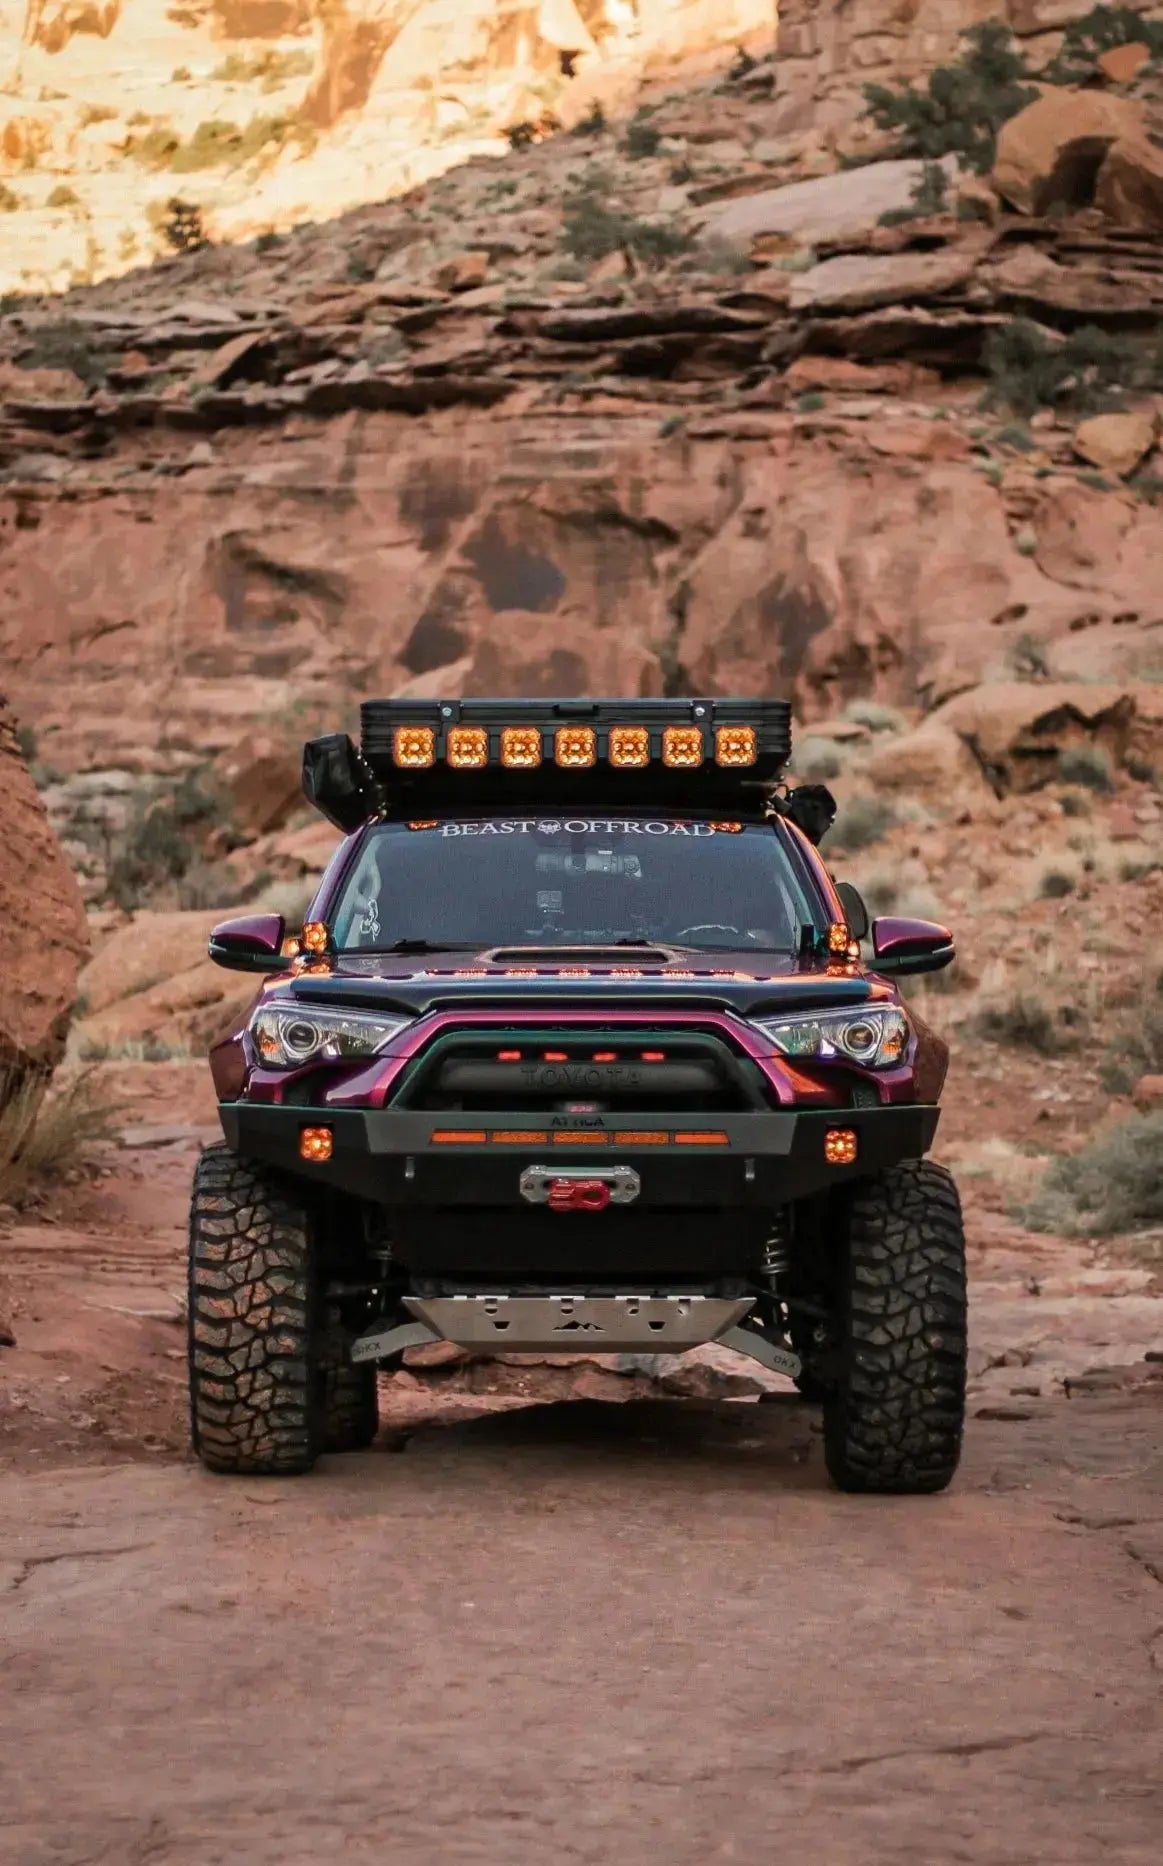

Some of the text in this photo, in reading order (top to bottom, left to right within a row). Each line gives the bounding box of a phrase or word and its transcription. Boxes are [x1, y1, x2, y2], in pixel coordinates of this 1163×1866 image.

[439, 820, 716, 837] BEAST OFFROAD
[520, 1066, 642, 1087] TOYOTA
